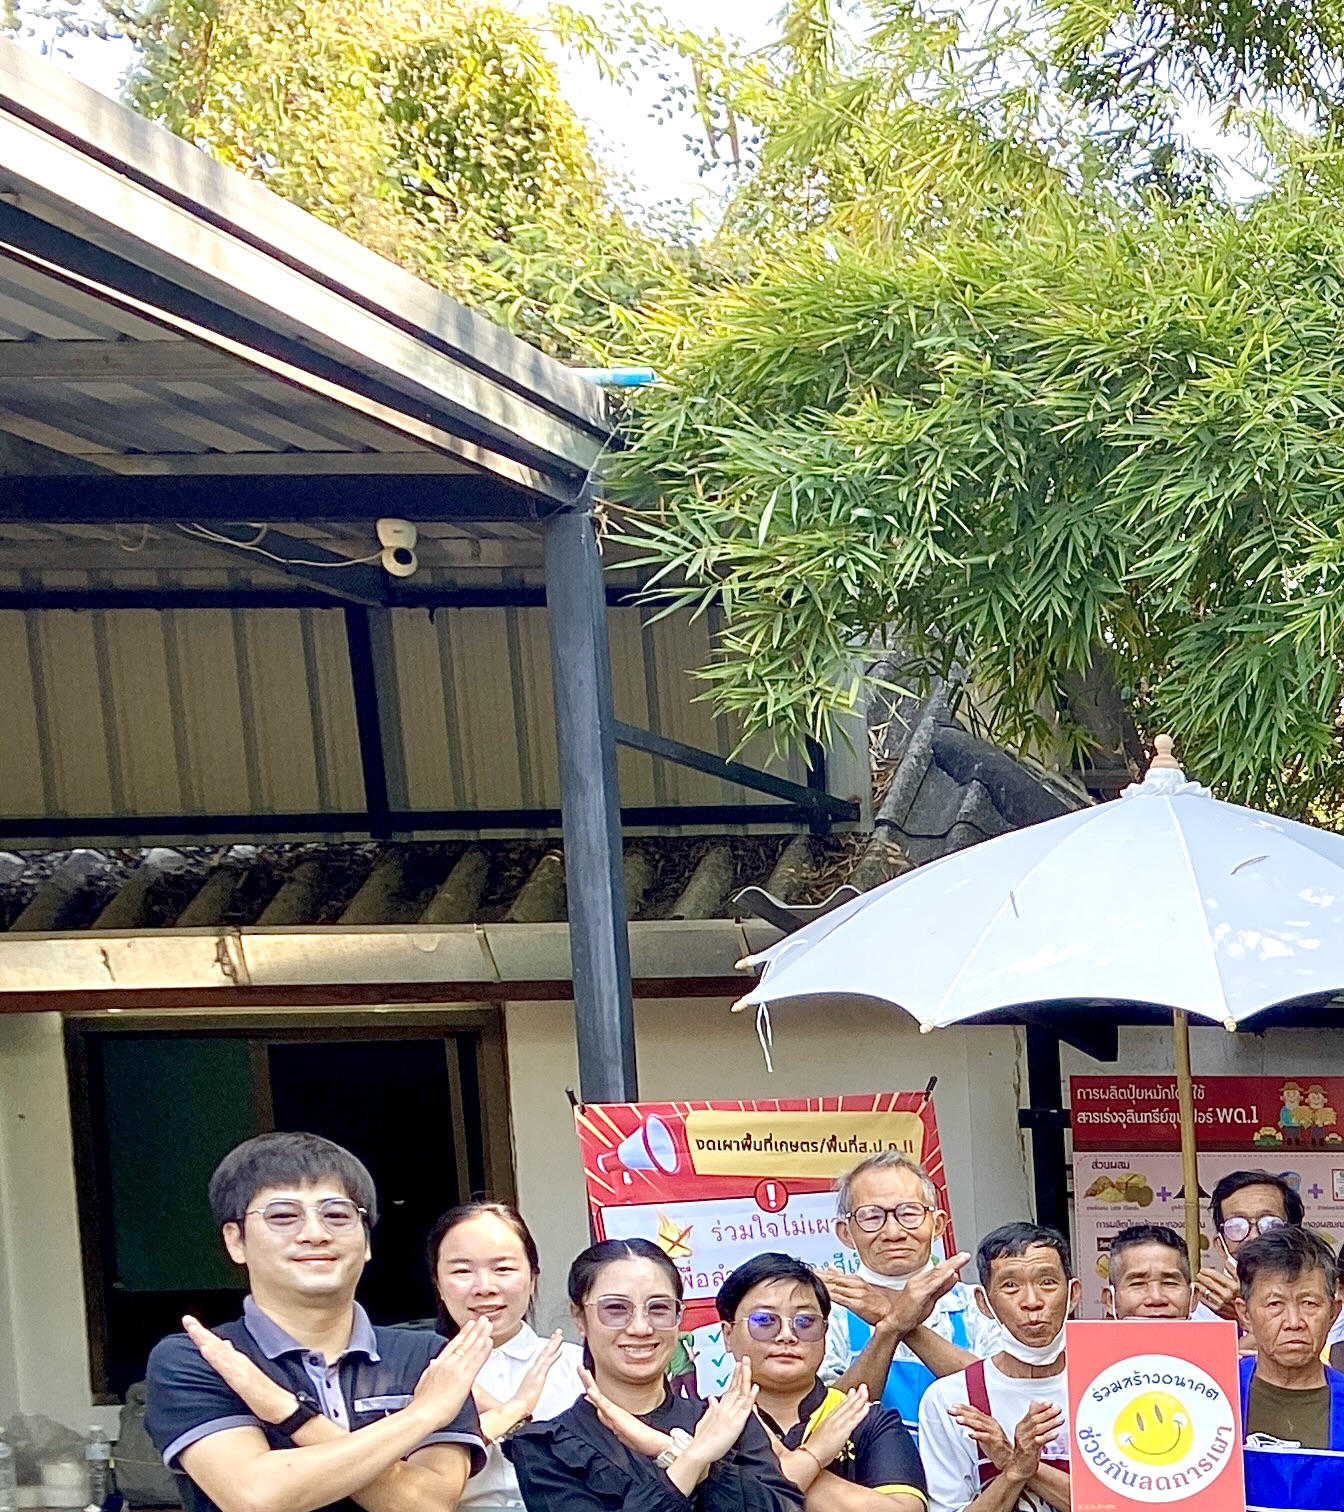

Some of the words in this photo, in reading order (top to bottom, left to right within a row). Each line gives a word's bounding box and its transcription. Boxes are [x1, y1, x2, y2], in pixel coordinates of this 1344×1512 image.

[1216, 1105, 1259, 1124] พด.1
[1091, 1159, 1130, 1170] ส่วนผสม
[1091, 1370, 1220, 1403] ร่วมสร้างอนาคต
[1078, 1425, 1233, 1491] ช่วยกันลดการเผา
